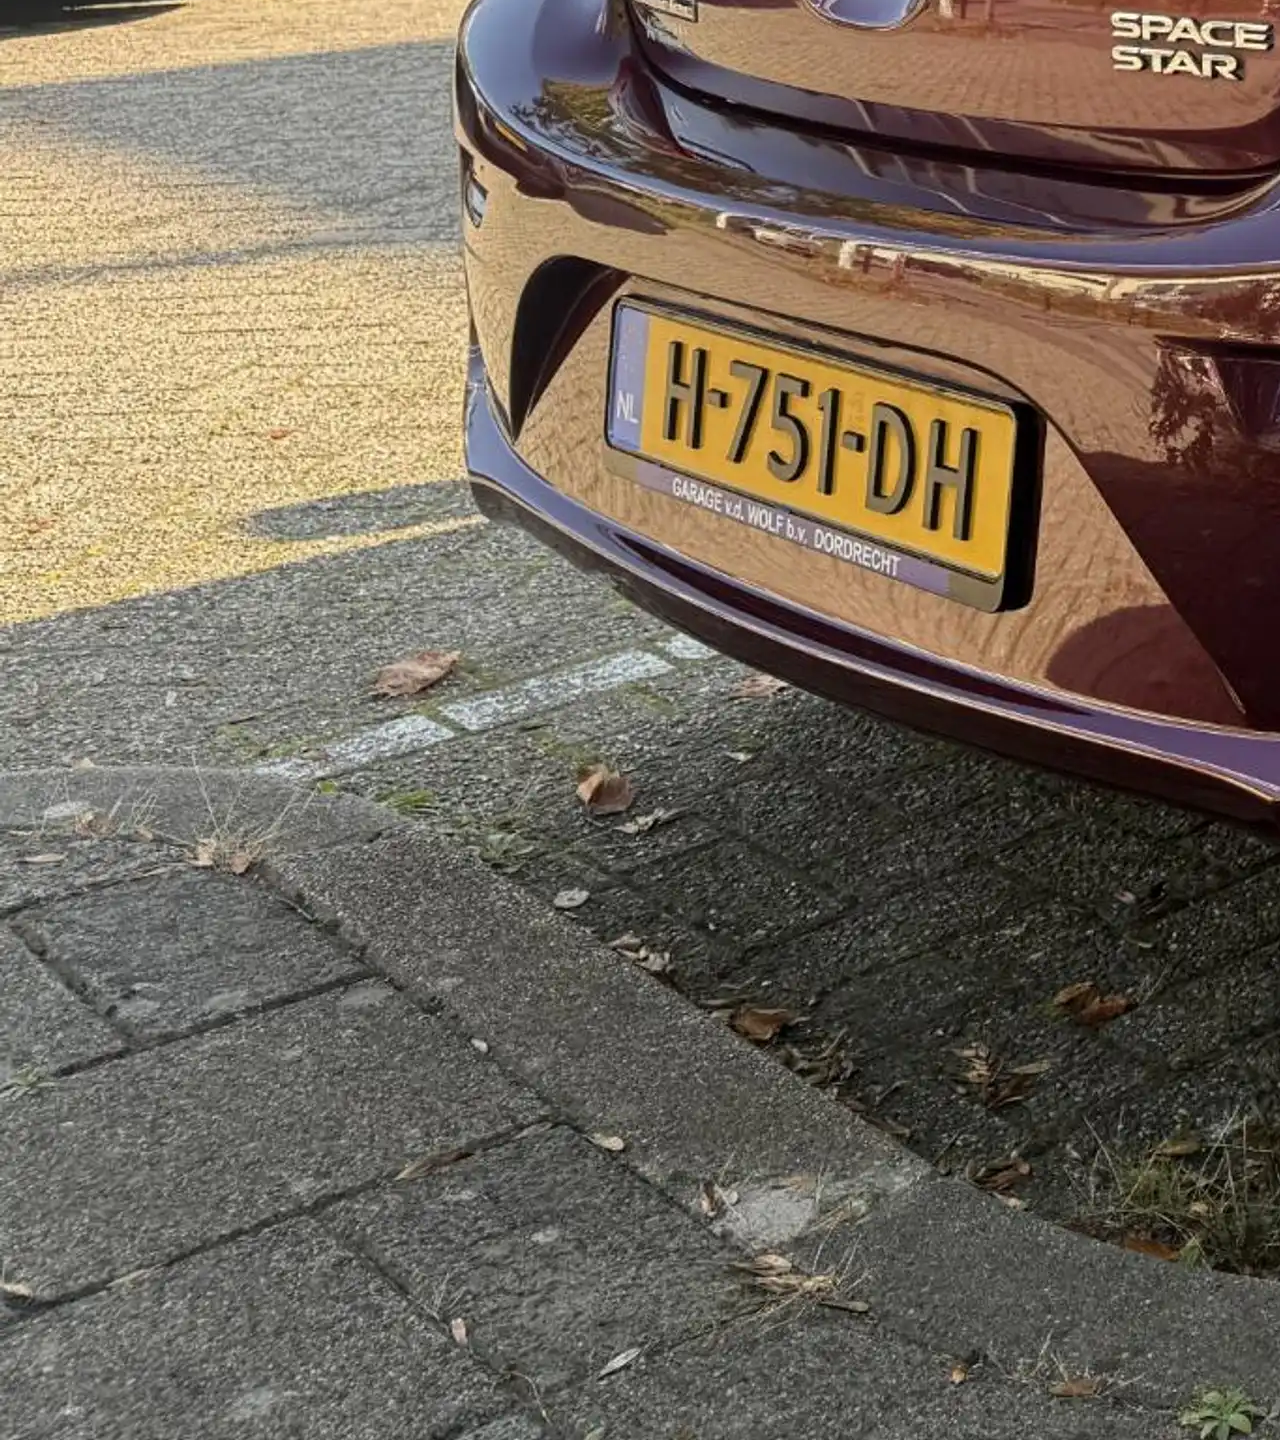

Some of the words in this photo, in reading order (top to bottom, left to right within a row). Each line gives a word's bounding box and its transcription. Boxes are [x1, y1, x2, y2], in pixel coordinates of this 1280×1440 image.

[1110, 11, 1274, 52] SPACE
[1110, 45, 1246, 81] STAR
[616, 390, 639, 425] NL
[662, 340, 981, 542] H-751-DH
[672, 476, 724, 513] GARAGE
[747, 502, 785, 536] WOLF
[813, 528, 903, 578] DORDRECHT
